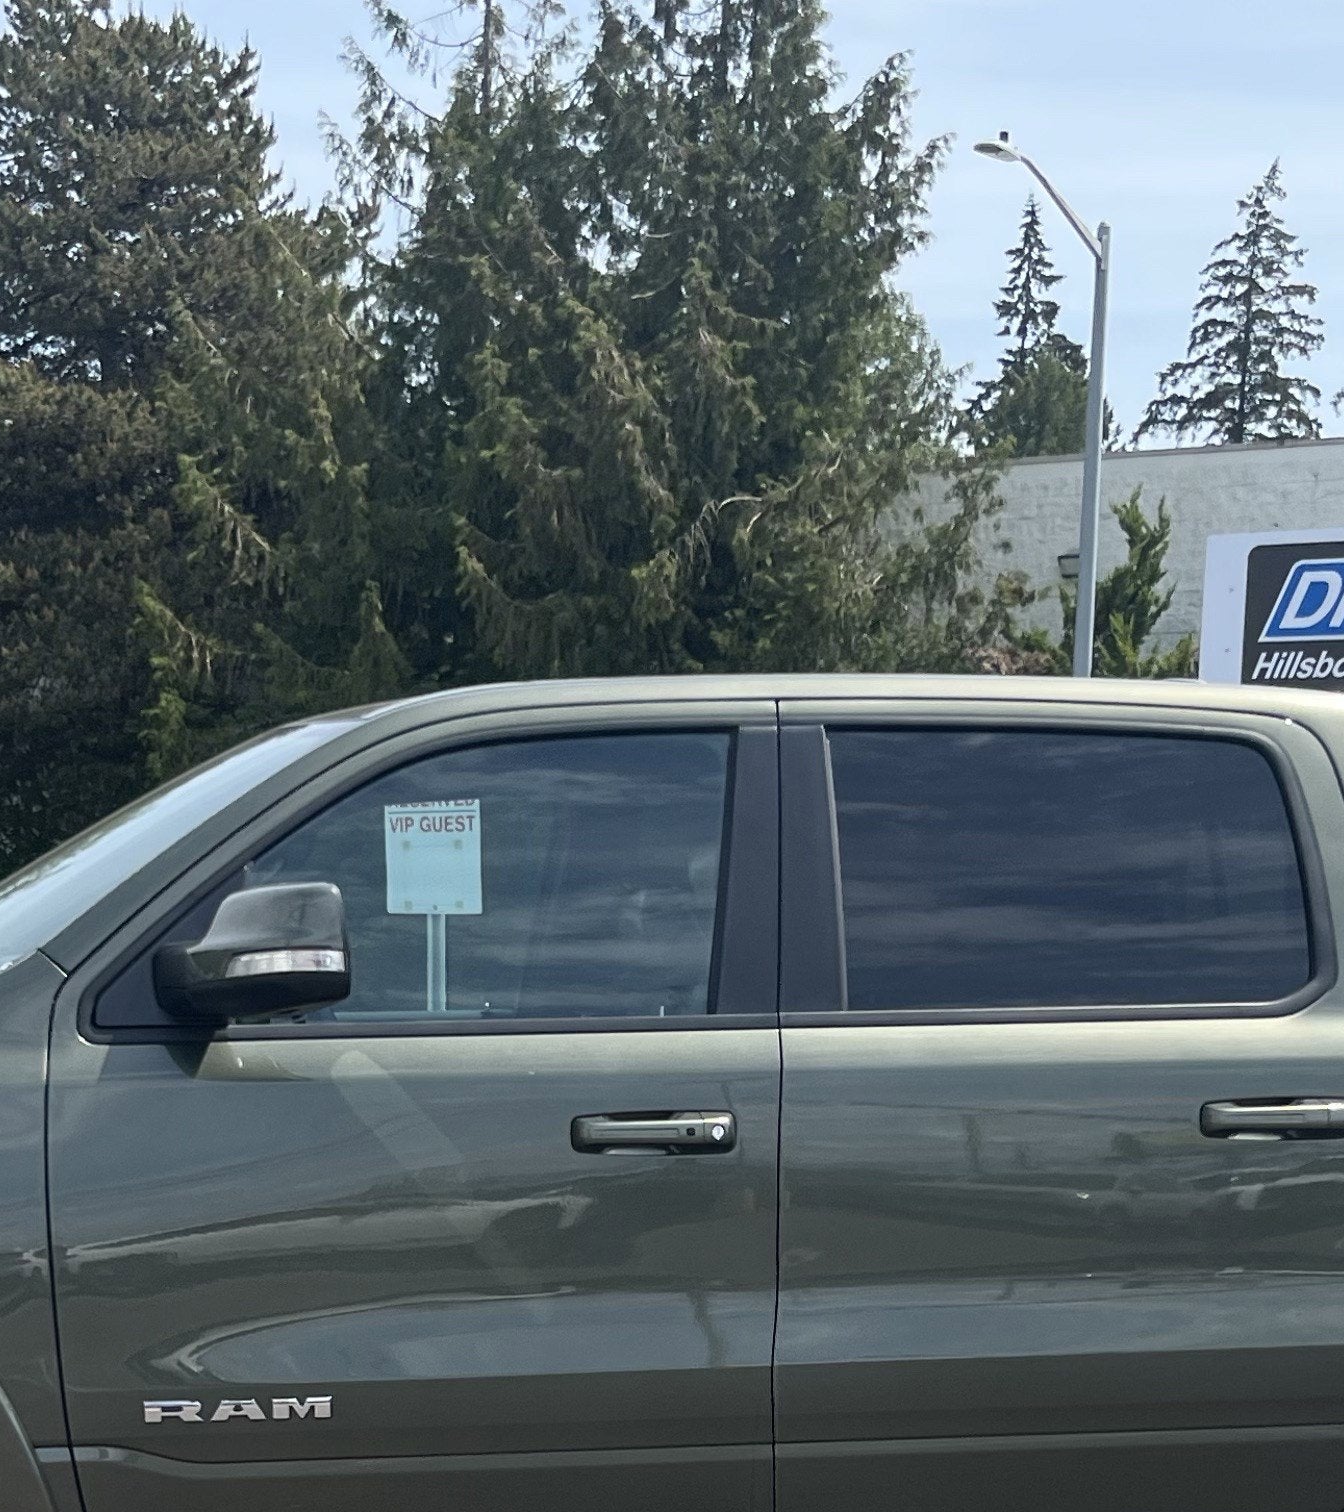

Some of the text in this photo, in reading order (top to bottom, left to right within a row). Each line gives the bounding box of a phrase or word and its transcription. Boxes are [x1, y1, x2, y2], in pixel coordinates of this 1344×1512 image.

[389, 815, 475, 833] VIP GUEST
[143, 1396, 333, 1424] RAM
